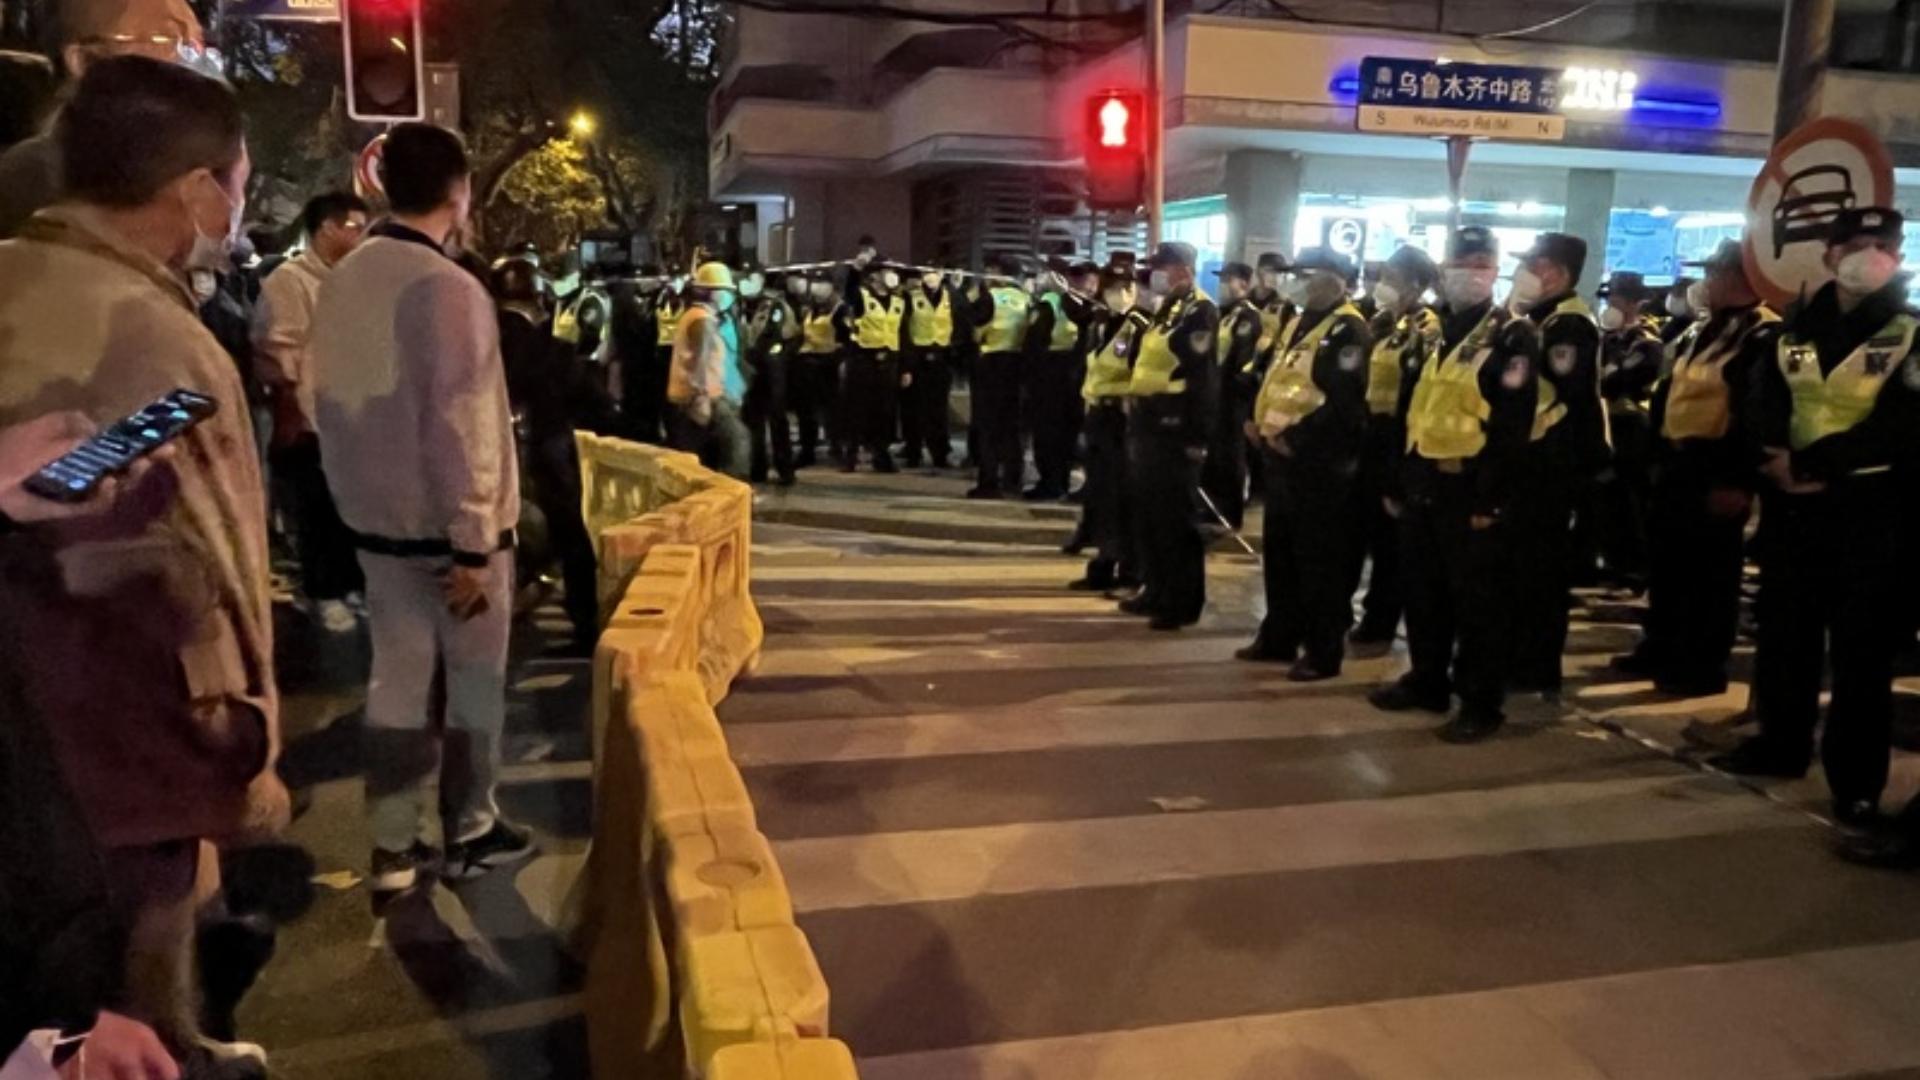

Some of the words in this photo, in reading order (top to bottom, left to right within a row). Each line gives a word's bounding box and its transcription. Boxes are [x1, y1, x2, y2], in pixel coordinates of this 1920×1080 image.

[1397, 70, 1532, 104] 乌鲁木齐中路
[1376, 110, 1386, 127] S
[1537, 120, 1549, 135] N
